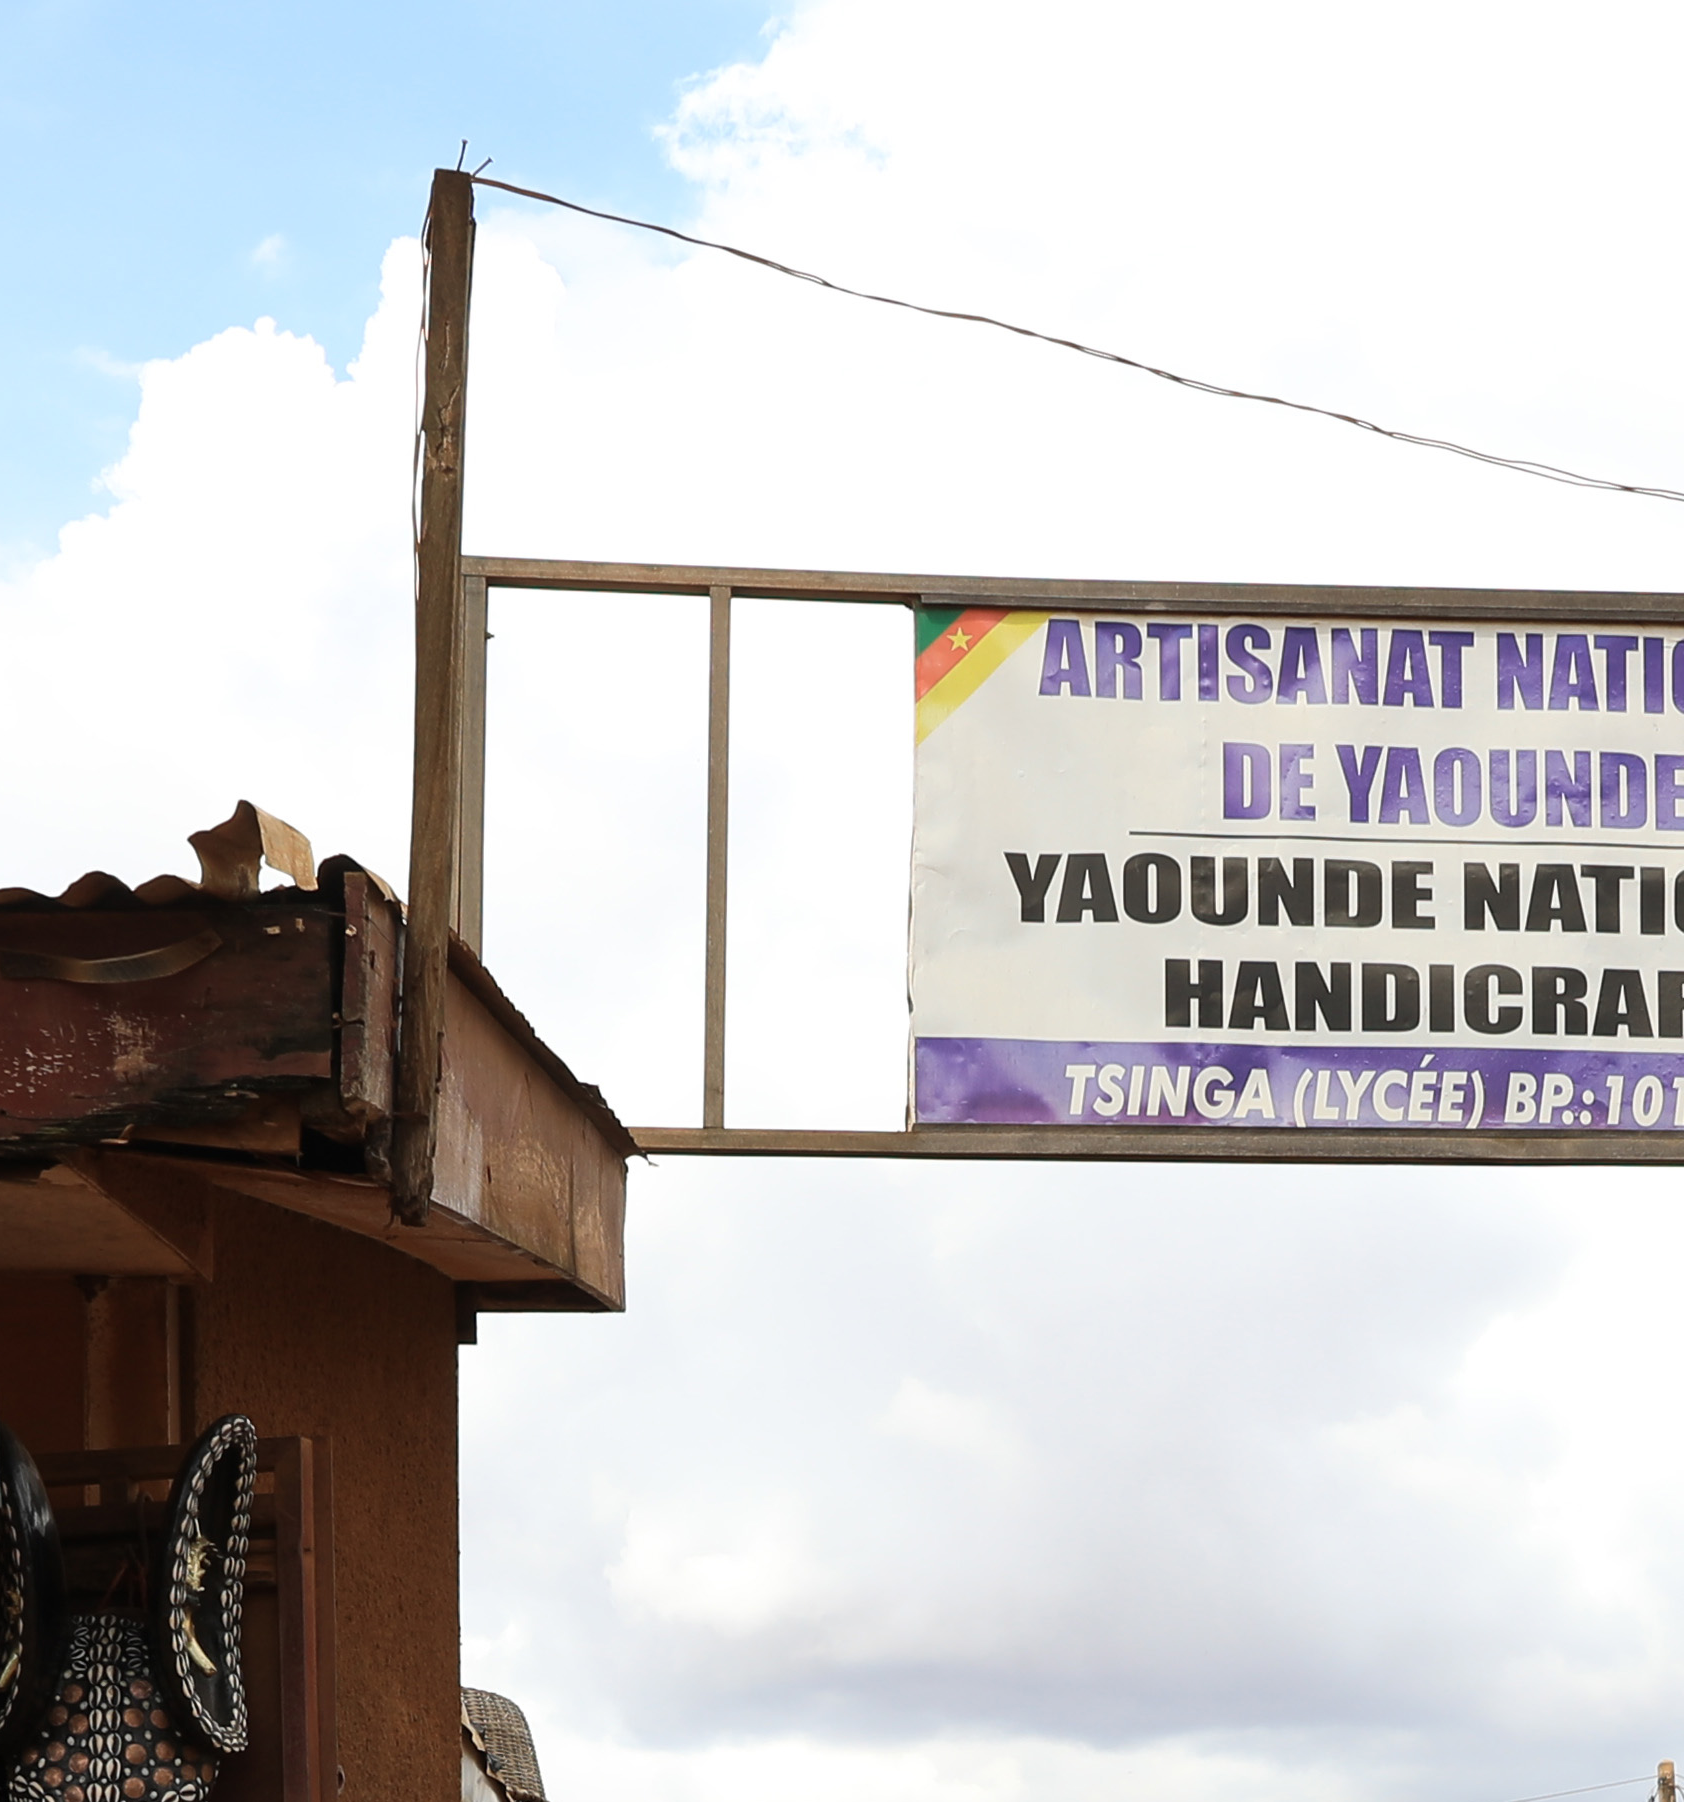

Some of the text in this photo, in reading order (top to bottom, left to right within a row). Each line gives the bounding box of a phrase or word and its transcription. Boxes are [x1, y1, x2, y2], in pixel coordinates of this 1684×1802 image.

[1038, 618, 1476, 710] ARTISANAT
[1222, 741, 1314, 822] DE
[1004, 852, 1436, 931] YAOUNDE
[1063, 1064, 1275, 1120] TSINGA
[1292, 1056, 1486, 1130] (LYCÉE)
